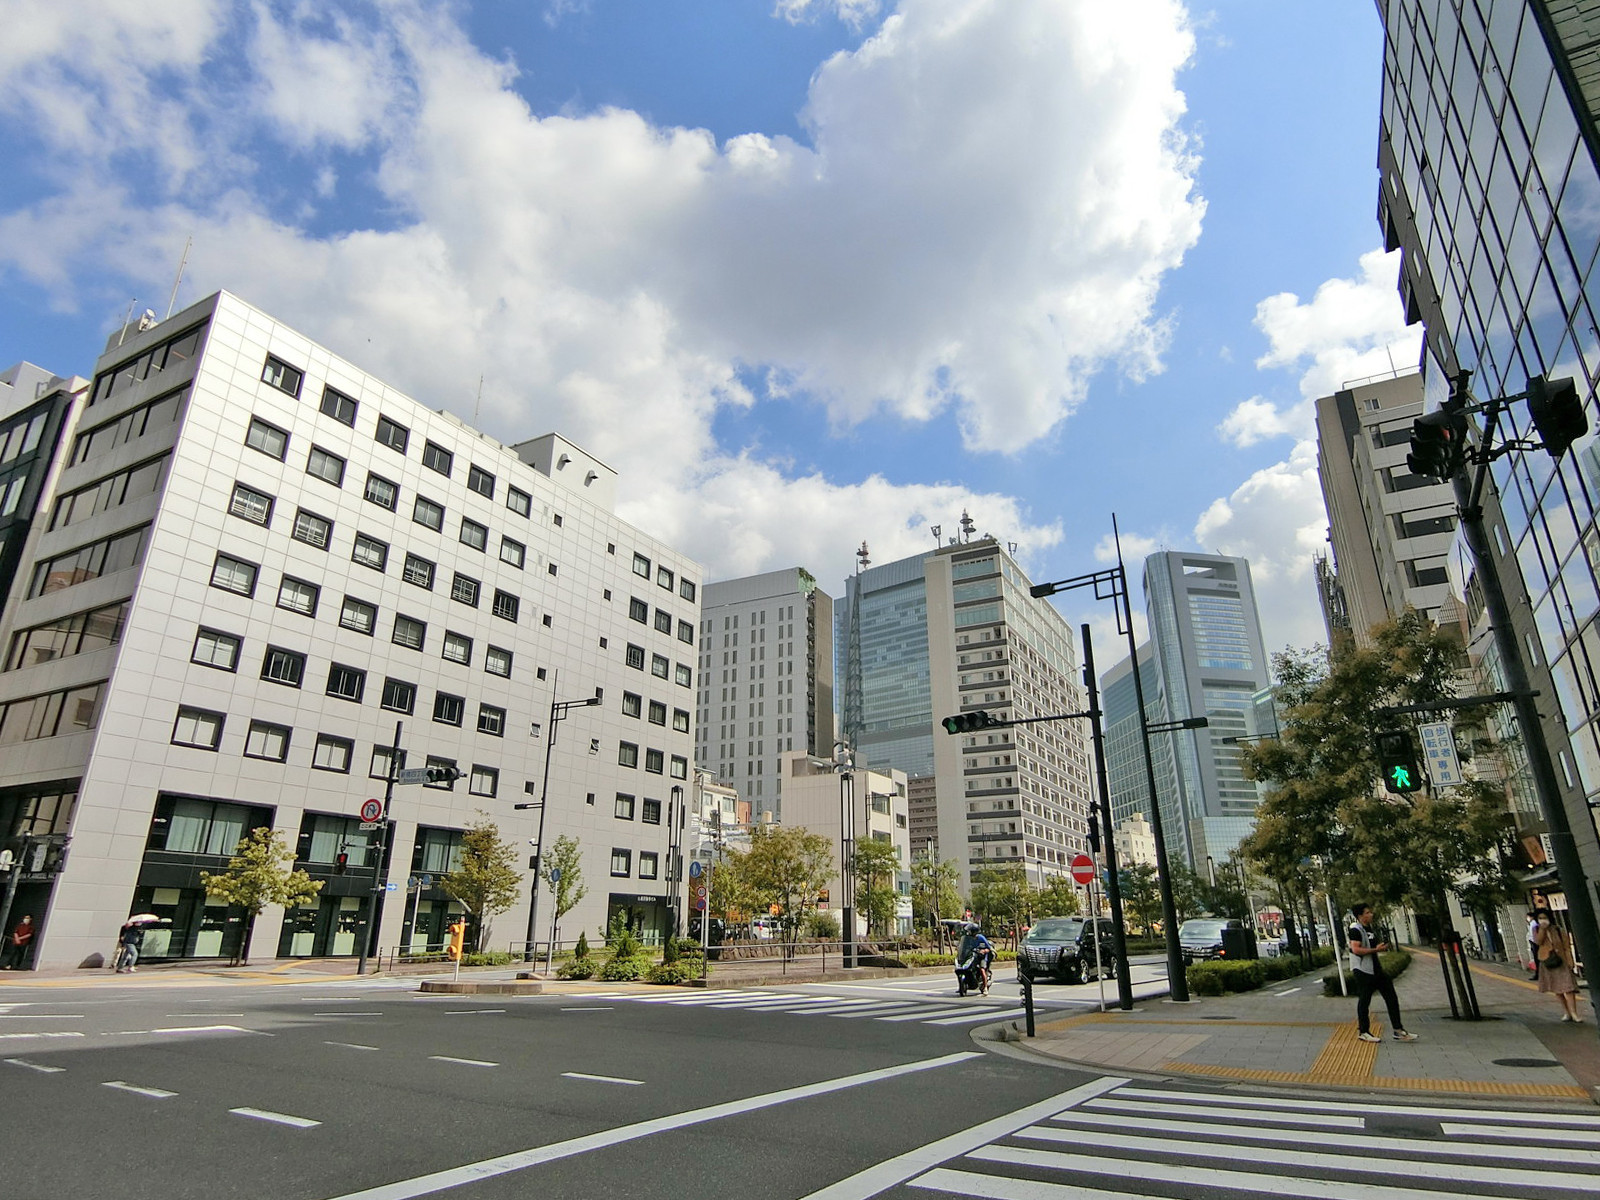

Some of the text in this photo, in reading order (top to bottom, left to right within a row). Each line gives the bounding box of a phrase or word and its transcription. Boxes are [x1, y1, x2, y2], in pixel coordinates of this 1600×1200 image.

[1424, 728, 1439, 758] 自転車
[1436, 727, 1451, 757] 歩行者
[1438, 760, 1451, 781] 専用
